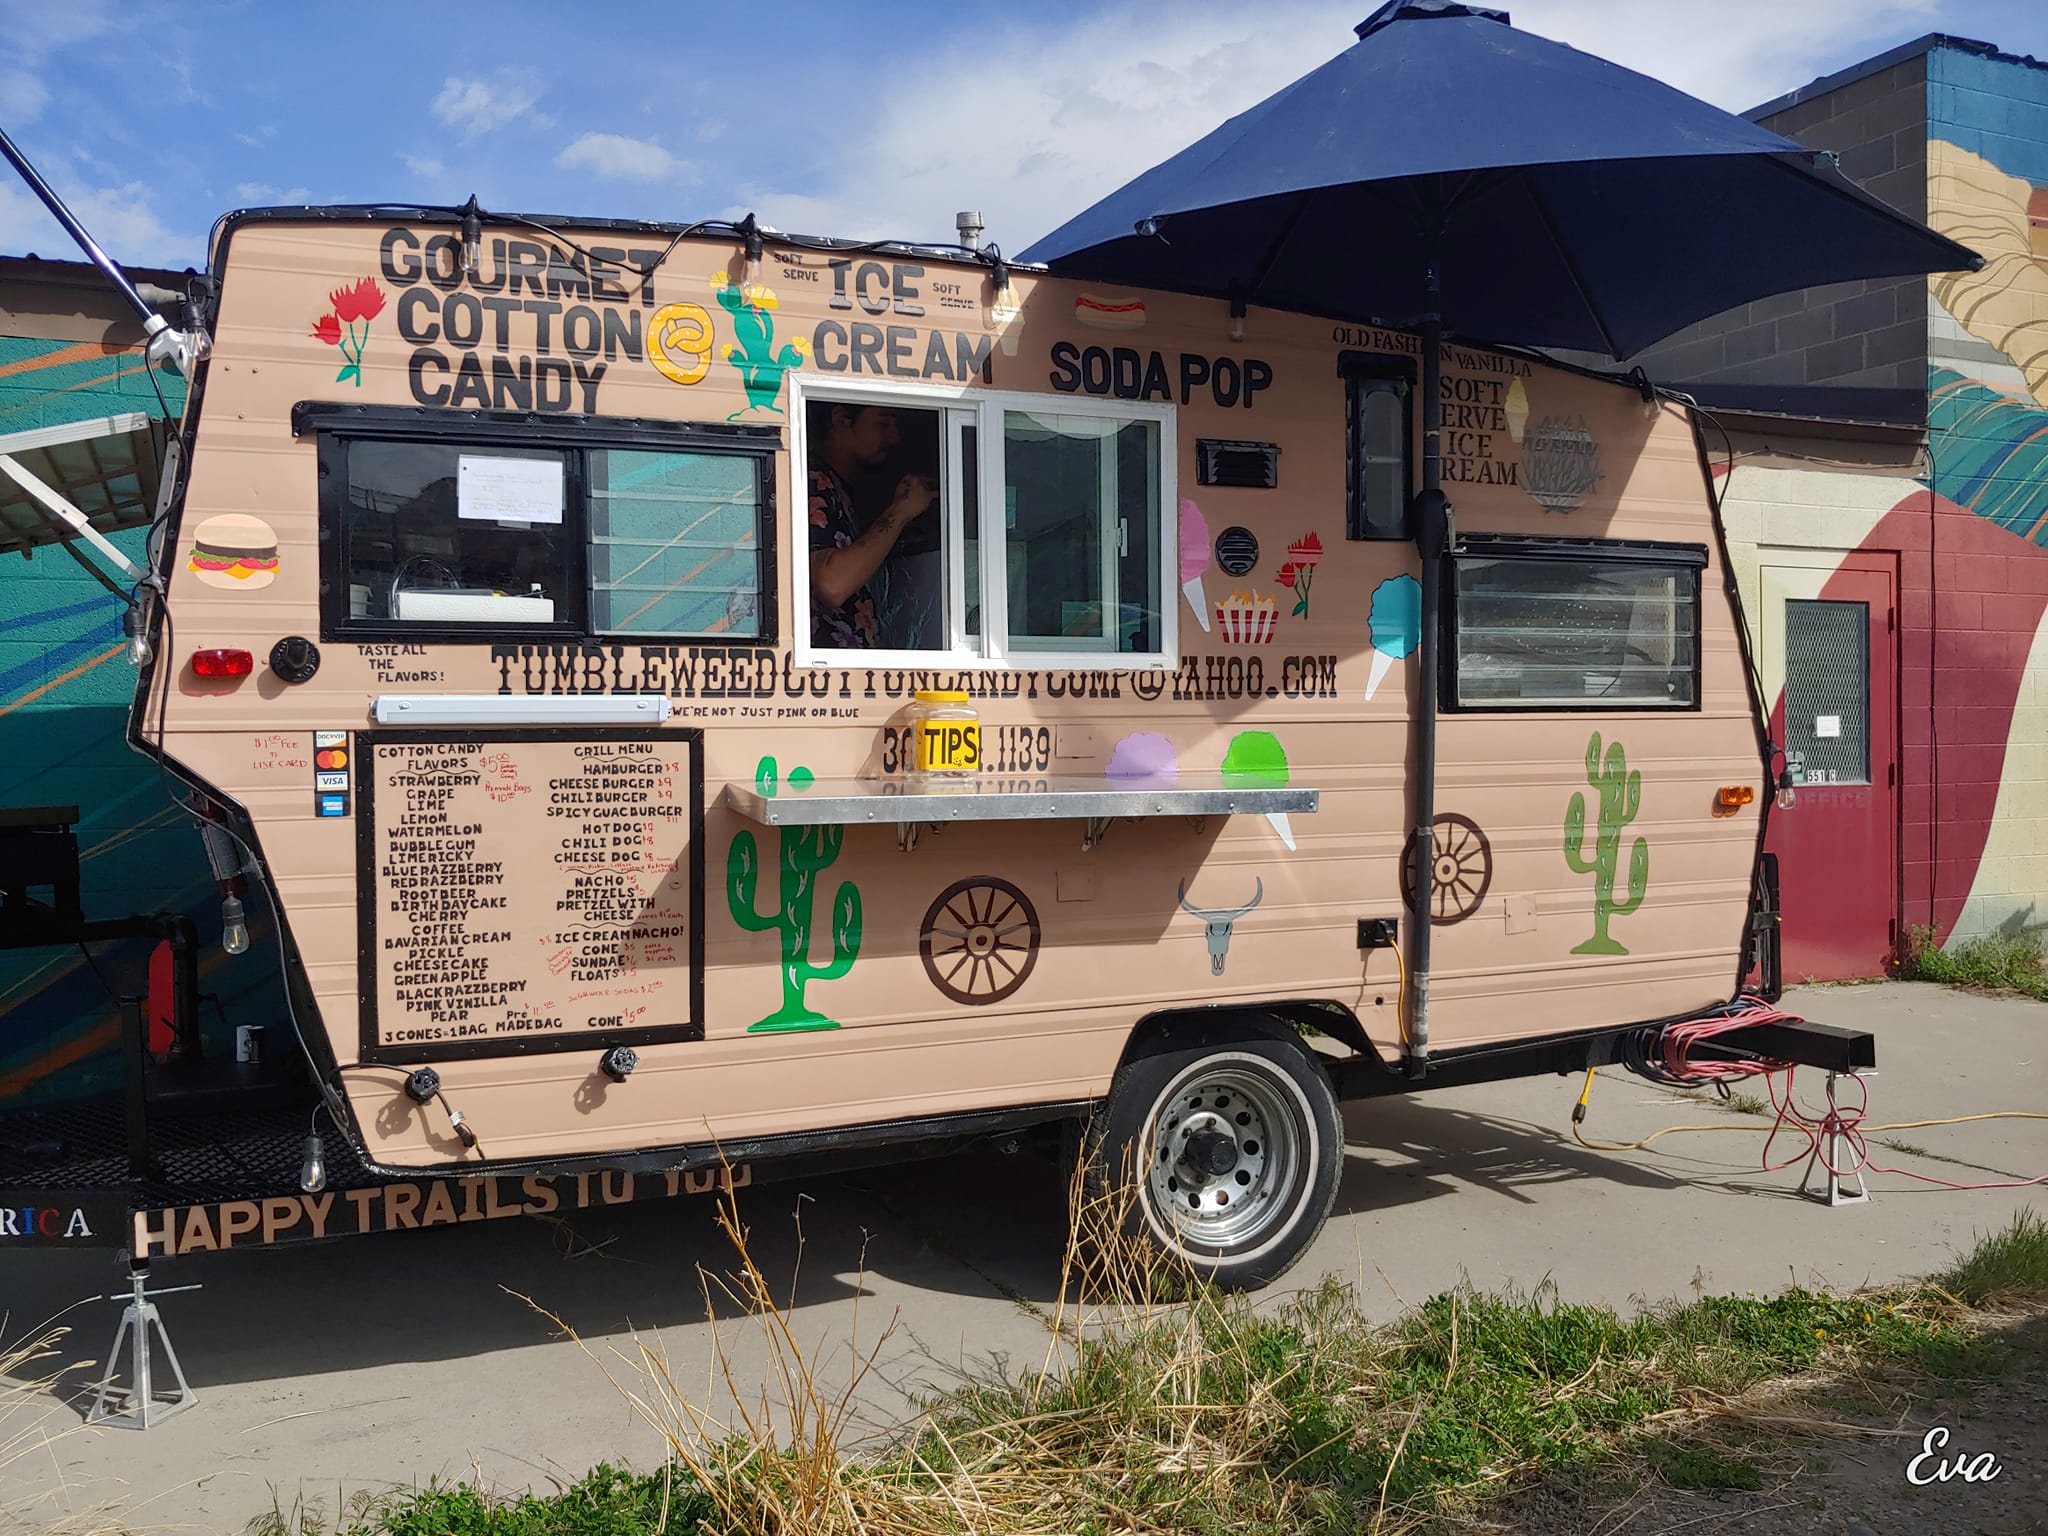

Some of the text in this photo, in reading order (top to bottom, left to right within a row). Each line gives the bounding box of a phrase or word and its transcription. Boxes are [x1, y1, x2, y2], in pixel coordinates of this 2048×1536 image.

[774, 254, 802, 265] SOFT
[380, 227, 667, 308] GOURMET
[784, 268, 818, 282] SERVE
[827, 257, 926, 317] ICE
[933, 282, 960, 296] SOFT
[941, 297, 974, 309] SERVE
[398, 287, 642, 362] COTTON
[813, 320, 992, 384] CREAM
[1333, 327, 1532, 377] OLD FASHN VANILLA
[409, 347, 607, 414] CANDY
[1050, 342, 1272, 408] SODA POP
[1440, 376, 1503, 404] SOFT
[1440, 404, 1506, 430] ERVE
[1448, 432, 1492, 457] ICE
[1440, 457, 1518, 485] REAM
[358, 644, 427, 656] TASTE ALL
[369, 659, 394, 669] THE
[378, 672, 444, 682] FLAVORS!
[673, 707, 859, 718] WE'RE NOT JUST PINK OR BLUE
[379, 744, 484, 758] COTTON CANDY
[575, 744, 653, 756] GRILL MENU
[924, 726, 978, 765] TIPS
[279, 760, 307, 768] CARD
[408, 758, 468, 770] FLAVORS
[584, 764, 662, 775] HAMBURGER
[389, 775, 481, 787] STRAWBERRY
[1808, 771, 1825, 782] 551
[407, 789, 454, 799] GRAPE
[551, 792, 592, 803] CHILI
[596, 792, 647, 803] BURGER
[408, 800, 445, 811] LIME
[547, 806, 682, 818] SPICY GUAC BURGER
[401, 813, 447, 825] LEMON
[388, 824, 482, 837] WATERMELON
[583, 823, 610, 833] HOT
[613, 823, 642, 833] DOG
[390, 840, 475, 852] BUBBLE GUM
[562, 838, 606, 848] CHILI
[613, 835, 641, 846] DOG
[554, 852, 605, 863] CHEESE
[612, 851, 640, 862] DOG
[383, 862, 502, 876] BLUE RAZZBERRY
[391, 874, 504, 888] RED RAZZBERRY
[575, 876, 624, 887] NACHO
[400, 888, 475, 900] ROOT BEER
[567, 888, 634, 899] PRETZELS
[557, 898, 655, 911] PRETZEL WITH
[409, 911, 468, 922] CHERRY
[584, 910, 633, 921] CHEESE
[412, 924, 465, 936] COFFEE
[556, 926, 684, 943] ICE CREAM NACHO!
[385, 932, 511, 949] BAVARIAN CREAM
[409, 947, 464, 959] PICKLE
[582, 944, 618, 955] CONE
[572, 955, 625, 968] SUNDAE
[395, 969, 486, 986] GREEN APPLE
[572, 968, 620, 981] FLOATS
[397, 986, 443, 1000] BLACK
[406, 995, 508, 1012] PINK VINILLA
[431, 1010, 468, 1022] PEAR
[588, 1016, 623, 1026] CONE
[496, 1018, 562, 1032] MADE BAG
[134, 1191, 335, 1259] HAPPY
[346, 1175, 559, 1233] TRAILS
